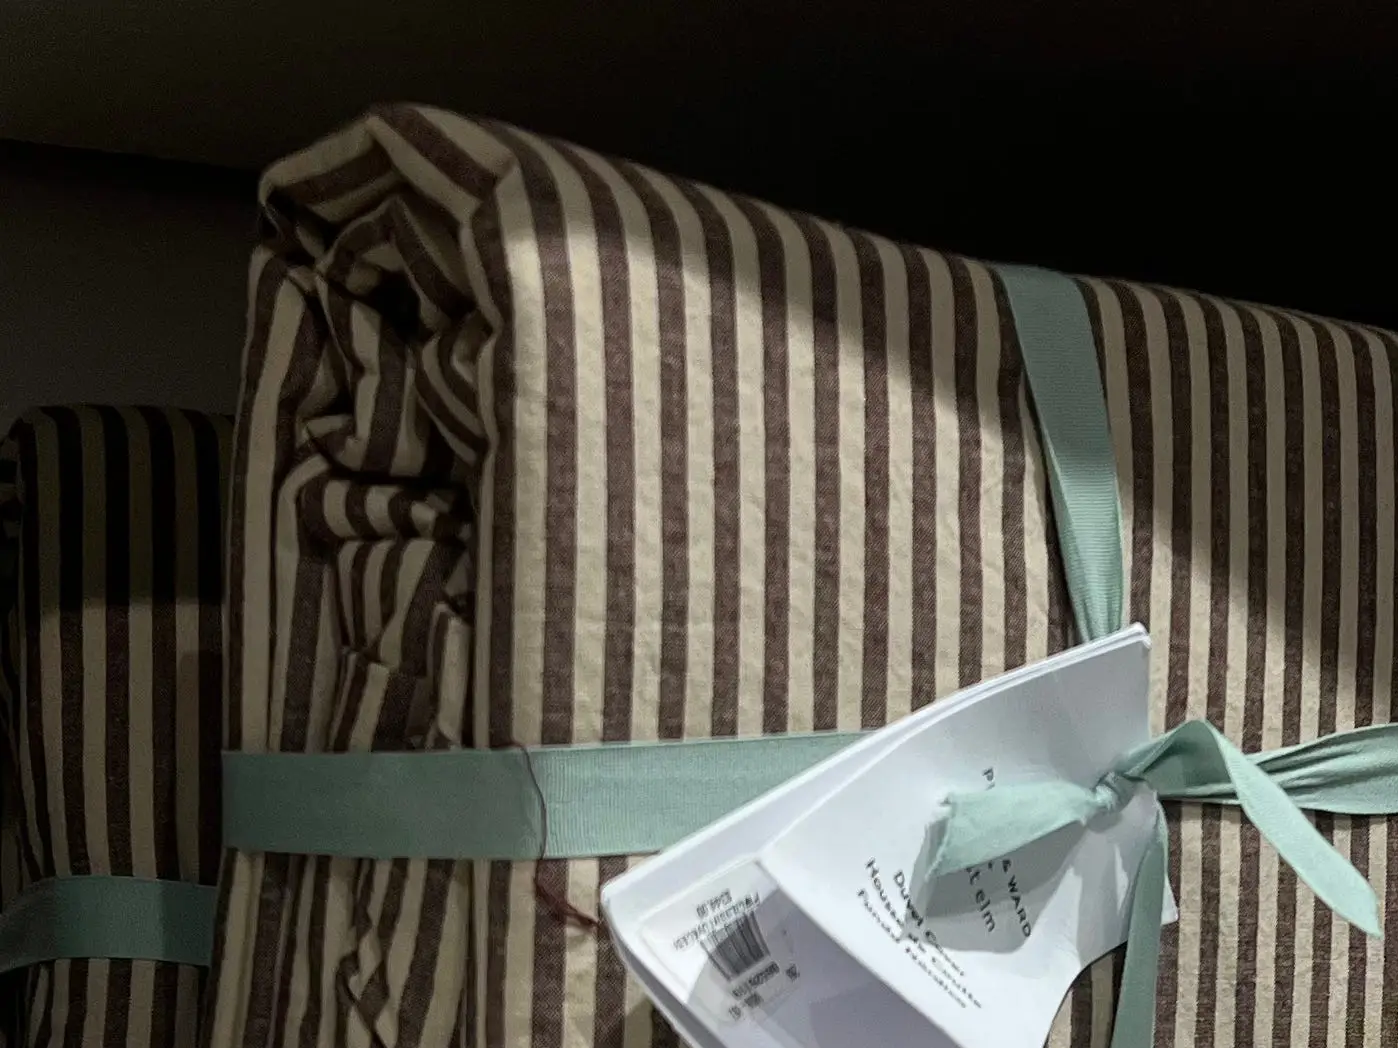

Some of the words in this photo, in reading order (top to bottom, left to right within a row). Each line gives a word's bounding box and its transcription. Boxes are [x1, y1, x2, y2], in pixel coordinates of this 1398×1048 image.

[894, 870, 924, 927] Duvet
[975, 889, 996, 932] elm
[1008, 875, 1032, 937] WARD
